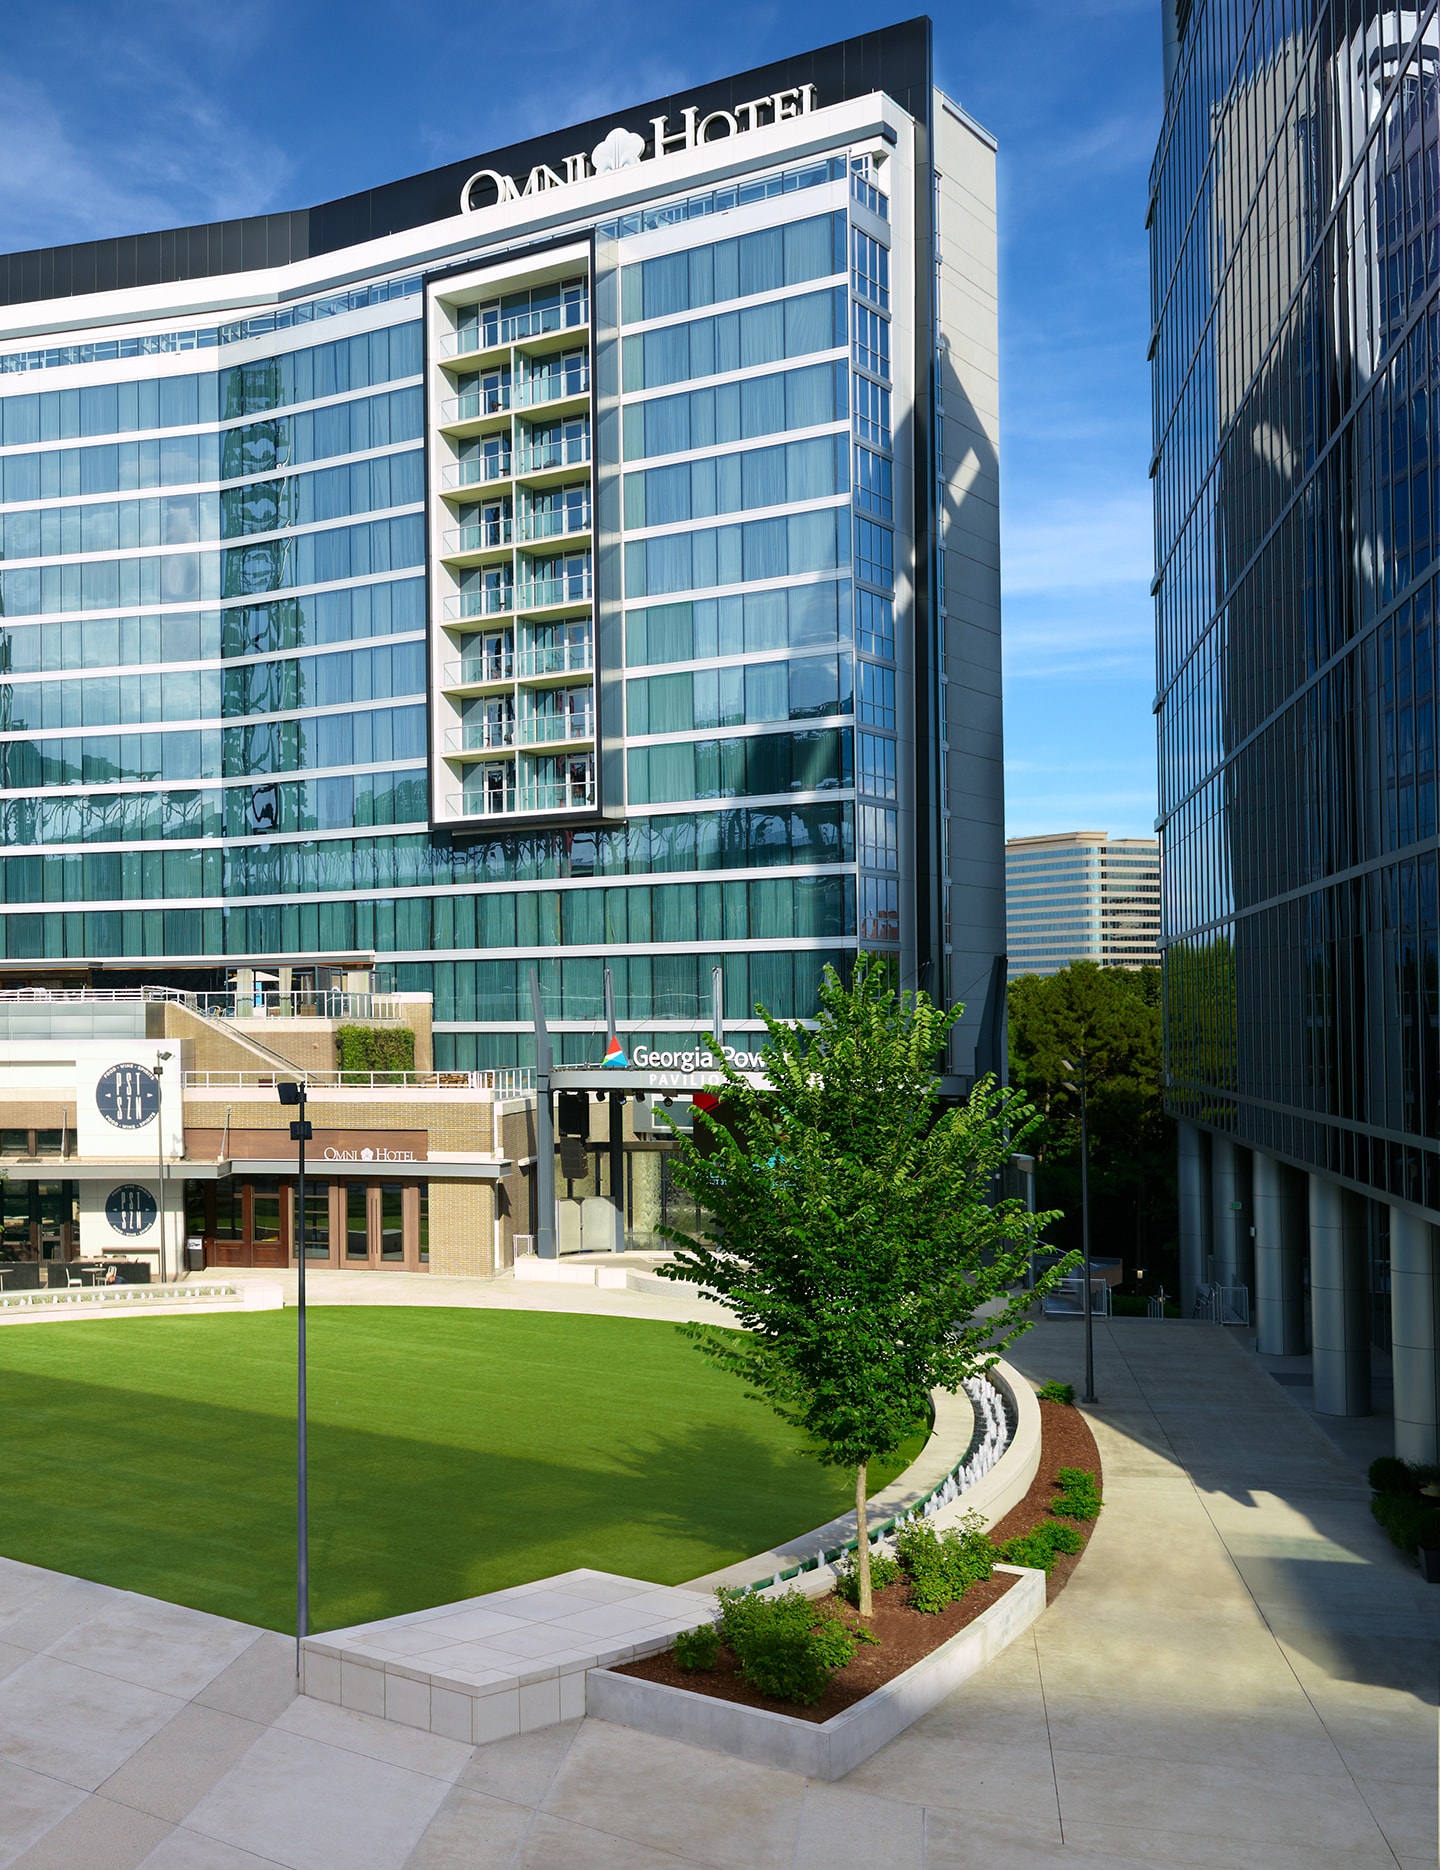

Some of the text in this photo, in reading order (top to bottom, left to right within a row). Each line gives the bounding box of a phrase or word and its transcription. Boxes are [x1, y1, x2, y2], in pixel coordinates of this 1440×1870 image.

[459, 82, 819, 215] OMNI HOTEL
[633, 1045, 714, 1073] Georgia
[104, 1066, 117, 1079] FOOD
[649, 1073, 726, 1087] PAVILIO
[116, 1072, 142, 1096] PST
[117, 1096, 142, 1120] SZN
[323, 1147, 417, 1161] OMNI HOTEL
[121, 1191, 141, 1210] PST
[121, 1210, 142, 1230] SZN
